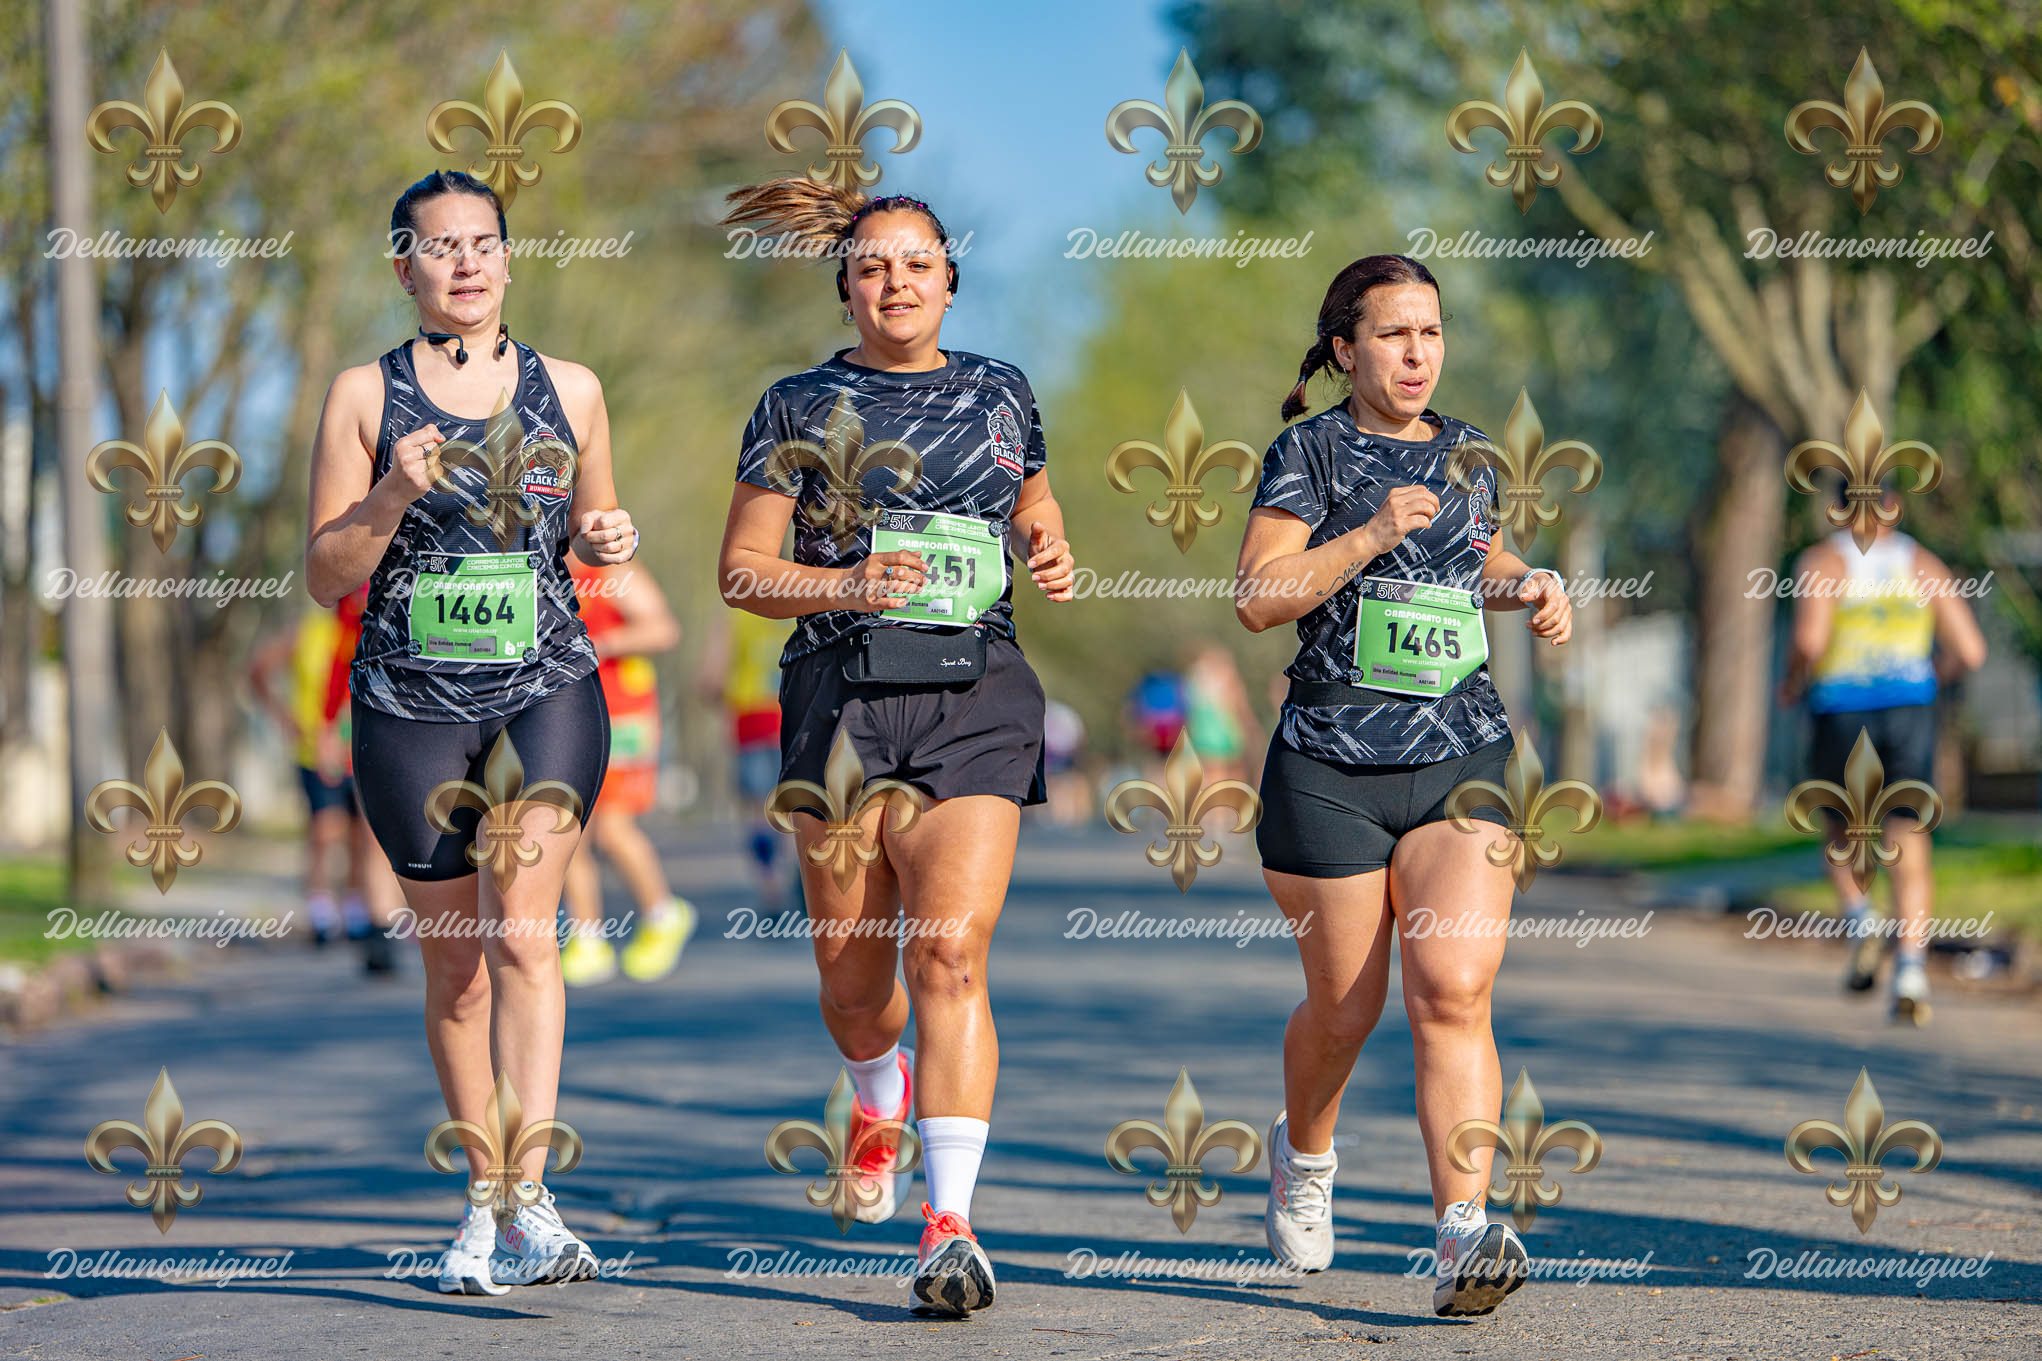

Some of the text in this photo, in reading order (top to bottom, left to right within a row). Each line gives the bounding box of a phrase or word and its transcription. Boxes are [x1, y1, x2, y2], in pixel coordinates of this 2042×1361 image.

[524, 474, 553, 486] BLACK
[889, 514, 915, 530] 5K
[897, 539, 960, 551] CAMPEONATO
[430, 556, 449, 573] 5K
[1376, 582, 1402, 600] 5K
[435, 593, 515, 625] 1464
[1384, 608, 1441, 623] CAMPEONATO
[1387, 622, 1462, 660] 1465
